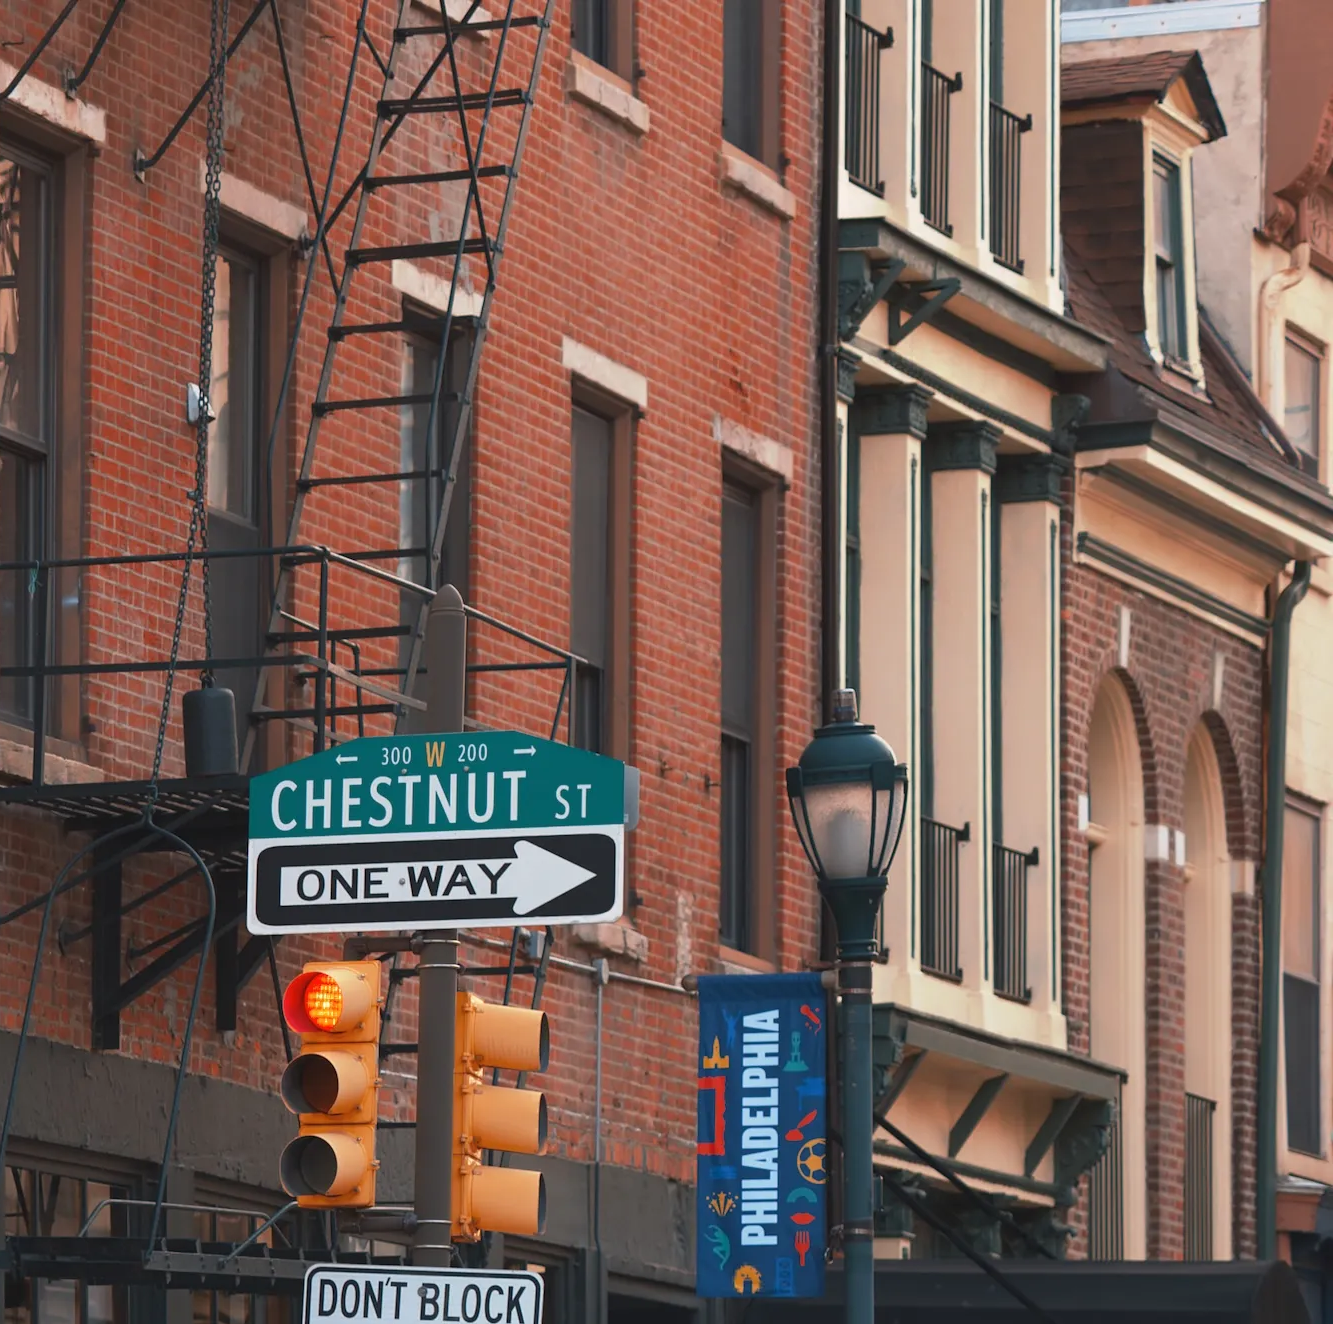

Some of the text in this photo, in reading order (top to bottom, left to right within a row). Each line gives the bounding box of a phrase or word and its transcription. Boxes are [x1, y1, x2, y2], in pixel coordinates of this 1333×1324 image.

[381, 741, 488, 768] 300 W 200
[271, 770, 592, 831] CHESTNUT ST
[296, 861, 512, 901] ONE WAY
[741, 1009, 780, 1246] PHILADELPHIA
[318, 1277, 526, 1324] DON'T BLOCK
